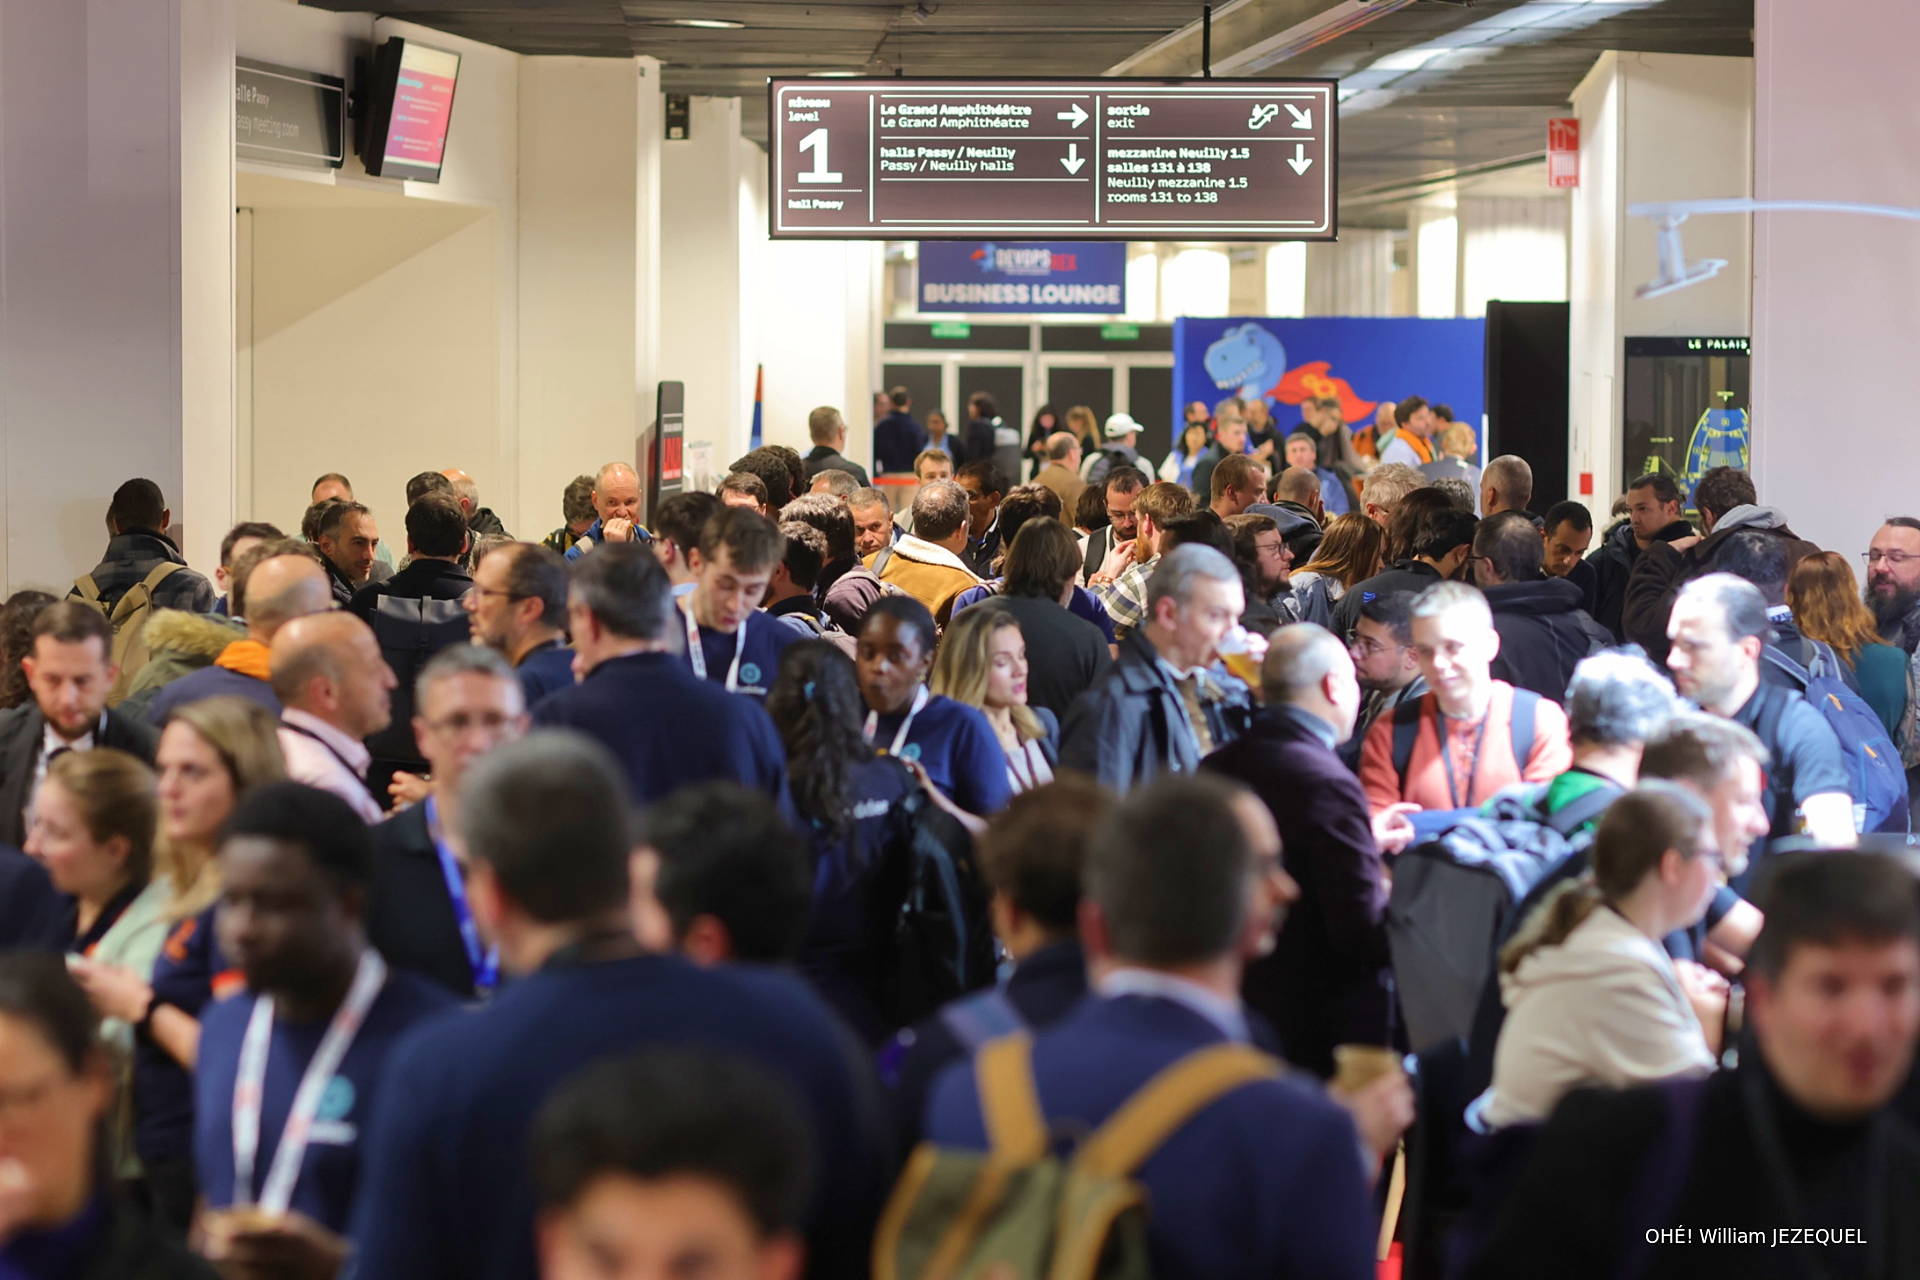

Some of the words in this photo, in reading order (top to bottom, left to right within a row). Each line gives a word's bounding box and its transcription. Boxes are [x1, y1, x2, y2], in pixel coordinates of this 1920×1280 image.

[236, 84, 251, 103] alle
[880, 103, 897, 115] Le
[898, 103, 938, 115] Grand
[1107, 103, 1151, 116] sortie
[788, 110, 820, 122] level
[880, 116, 897, 128] Le
[898, 116, 937, 128] Grand
[1107, 117, 1136, 128] exit
[797, 128, 843, 184] 1
[880, 146, 916, 159] halls
[917, 147, 956, 160] Passy
[957, 146, 965, 159] /
[966, 146, 1016, 160] Neuilly
[1107, 147, 1177, 159] mezzanine
[1178, 147, 1229, 161] Neuilly
[1230, 147, 1250, 159] 1.5
[880, 159, 918, 173] Passy
[919, 159, 928, 172] /
[929, 160, 978, 173] Neuilly
[980, 160, 1015, 172] halls
[1107, 162, 1149, 173] salles
[1151, 162, 1175, 173] 131
[1176, 162, 1186, 173] à
[1187, 162, 1211, 174] 138
[1107, 176, 1155, 190] Neuilly
[1157, 177, 1226, 188] mezzanine
[1228, 177, 1248, 189] 1.5
[1107, 192, 1148, 203] rooms
[1150, 191, 1174, 203] 131
[1176, 192, 1192, 203] to
[1194, 191, 1218, 203] 138
[788, 199, 811, 210] hall
[812, 199, 844, 211] Passy
[923, 283, 1030, 304] BUSINESS
[1031, 284, 1121, 305] LOUNGE
[1688, 339, 1702, 350] LE
[1706, 339, 1748, 350] PALAIS
